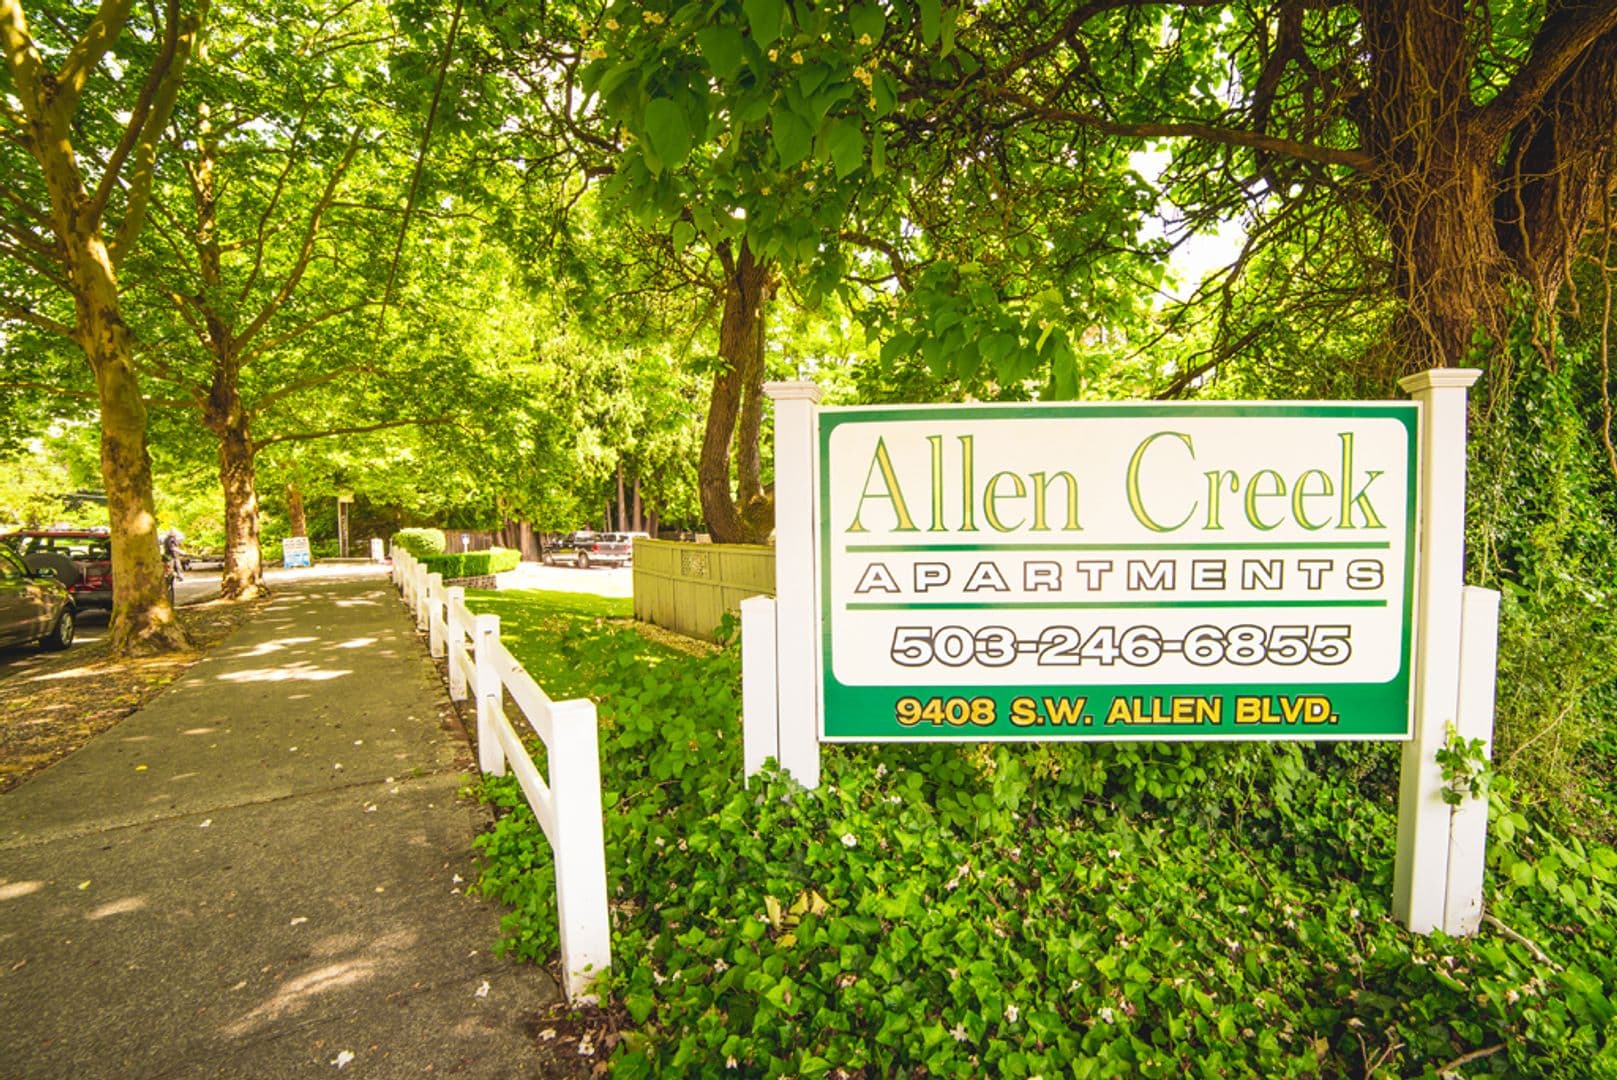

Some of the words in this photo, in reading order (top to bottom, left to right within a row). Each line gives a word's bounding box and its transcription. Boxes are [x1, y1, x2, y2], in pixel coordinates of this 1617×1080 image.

[845, 434, 1084, 533] Allen
[1126, 431, 1387, 532] Creek
[854, 559, 1384, 593] APARTMENTS
[890, 624, 1352, 667] 503-246-6855
[895, 696, 996, 726] 9408
[1009, 696, 1093, 726] S.W.
[1105, 696, 1221, 725] ALLEN
[1234, 696, 1339, 725] BLVD.
